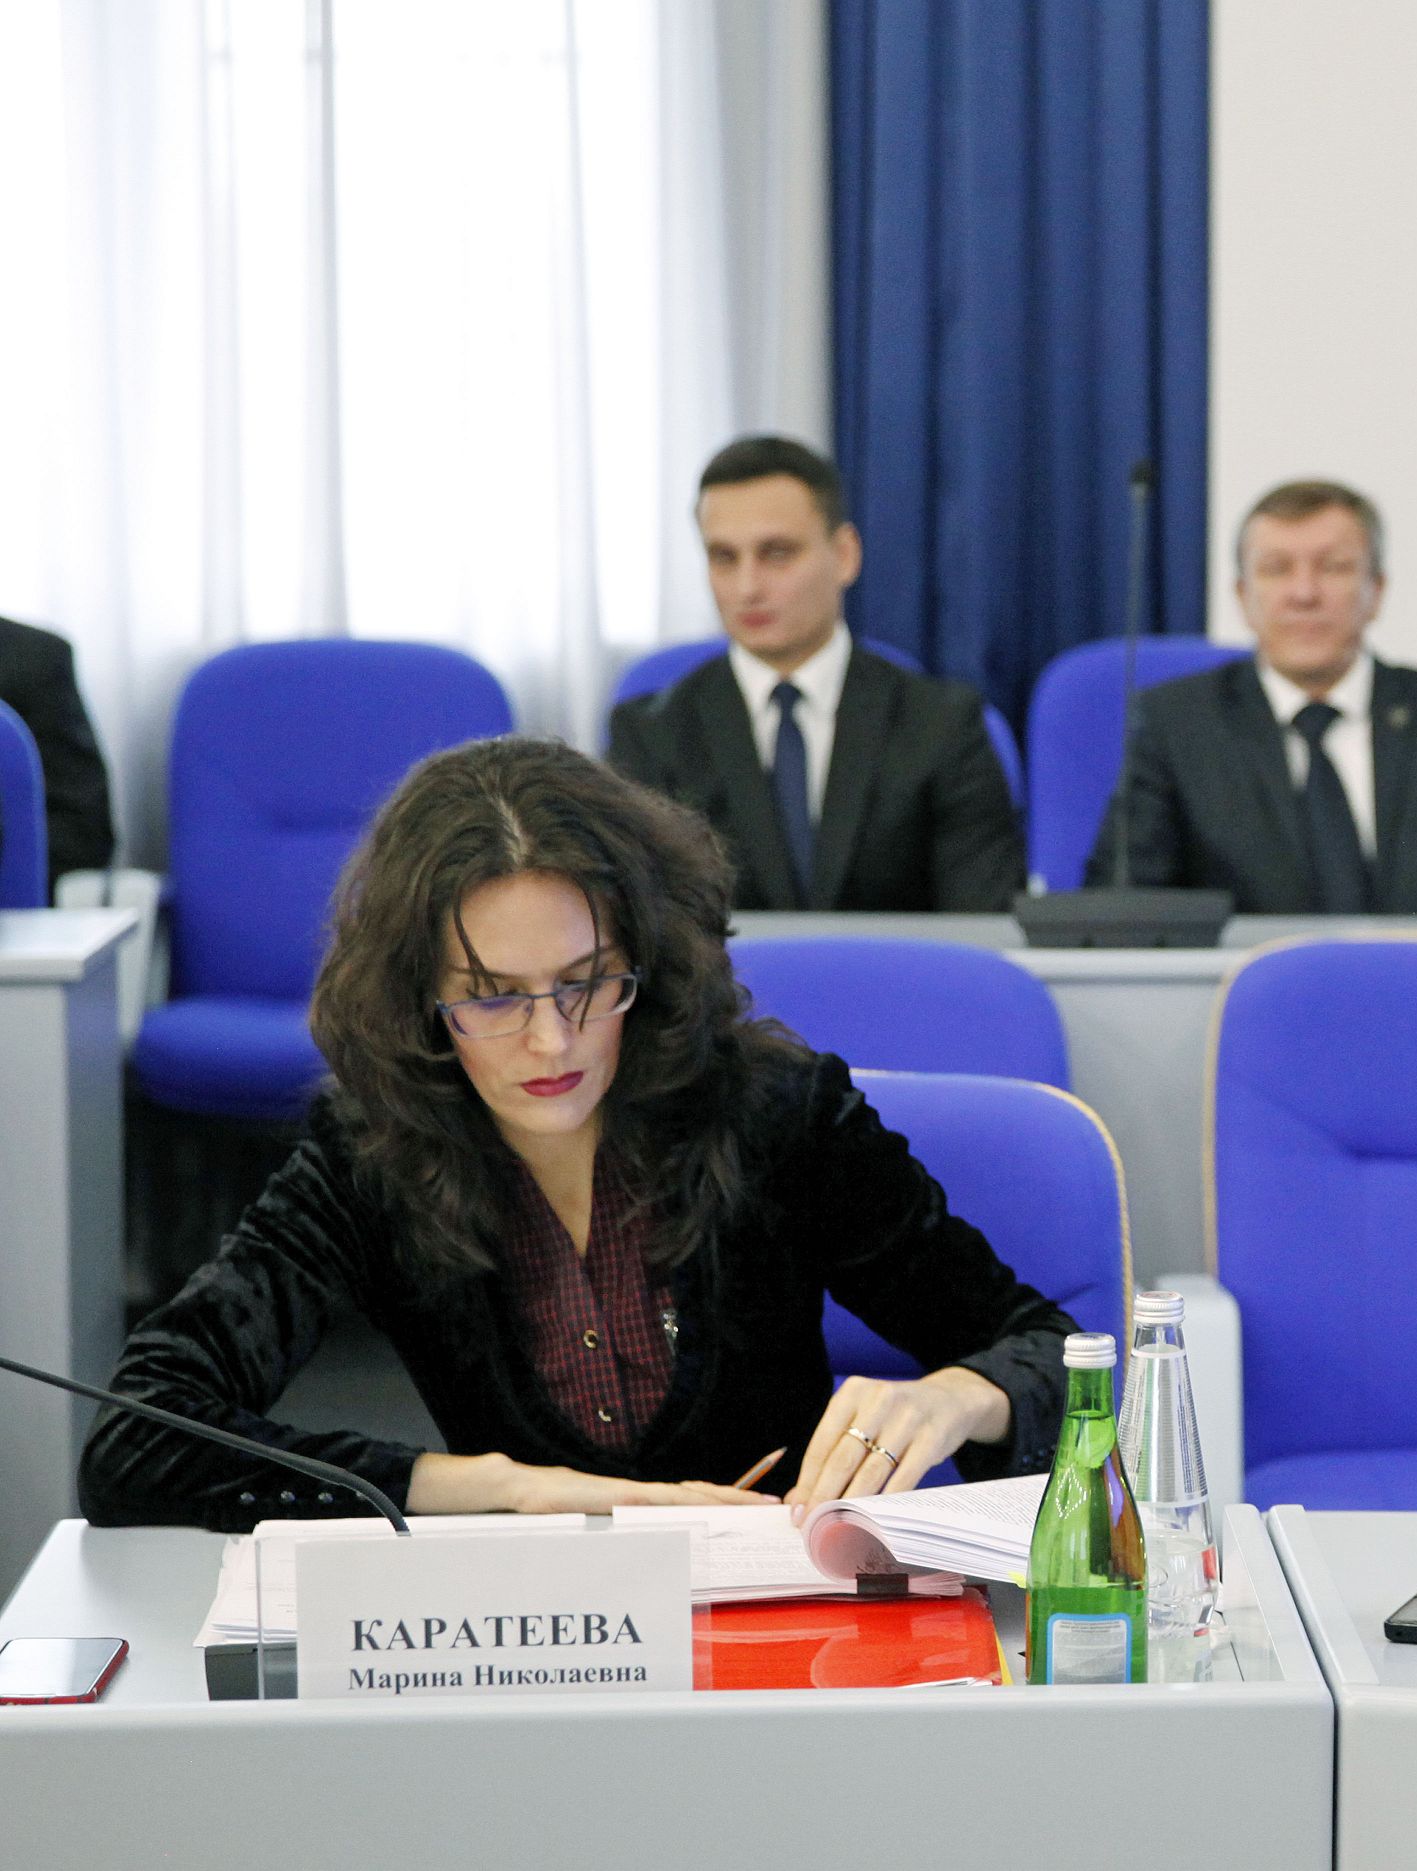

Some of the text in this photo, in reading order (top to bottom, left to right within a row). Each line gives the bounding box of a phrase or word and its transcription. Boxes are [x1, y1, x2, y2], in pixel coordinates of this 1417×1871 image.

[352, 1613, 642, 1651] КАРАТЕЕВА
[349, 1664, 647, 1694] Марина Николаевна
